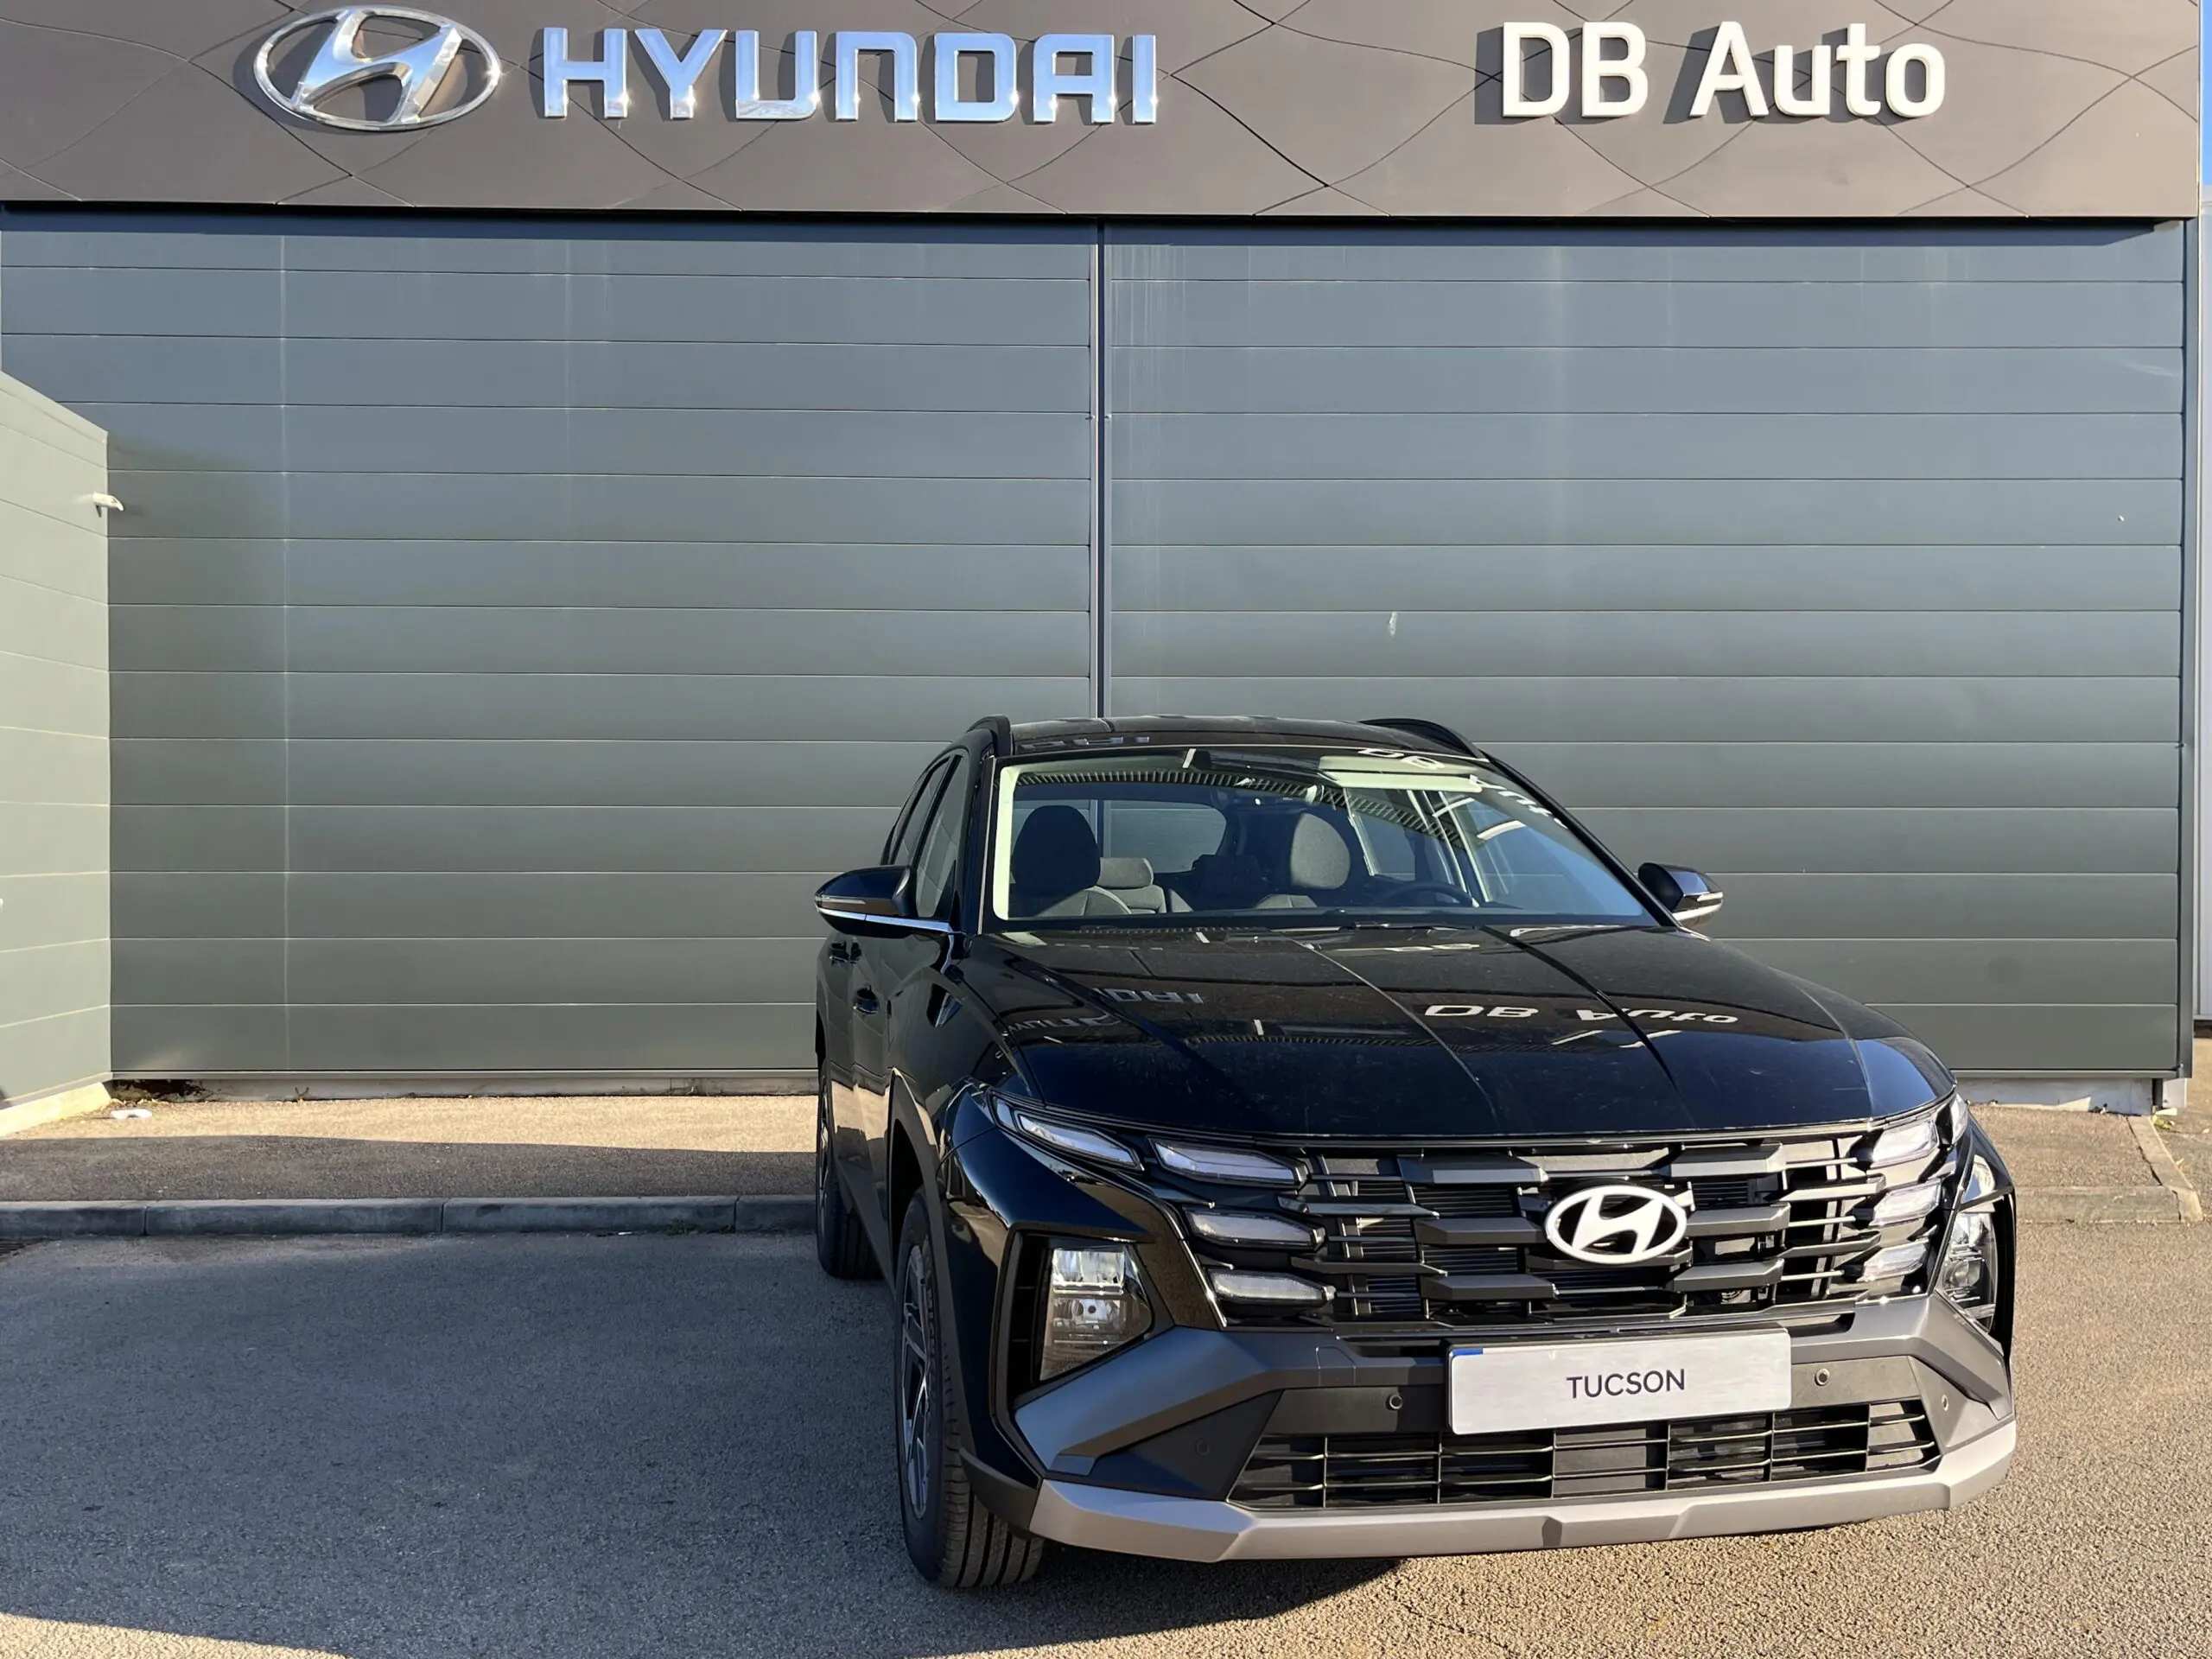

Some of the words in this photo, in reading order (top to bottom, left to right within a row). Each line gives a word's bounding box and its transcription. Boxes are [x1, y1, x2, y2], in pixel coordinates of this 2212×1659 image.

[543, 26, 1158, 124] HYUNDAI
[1502, 21, 1649, 118] DB
[1689, 20, 1946, 118] Auto
[1566, 1368, 1685, 1399] TUCSON
